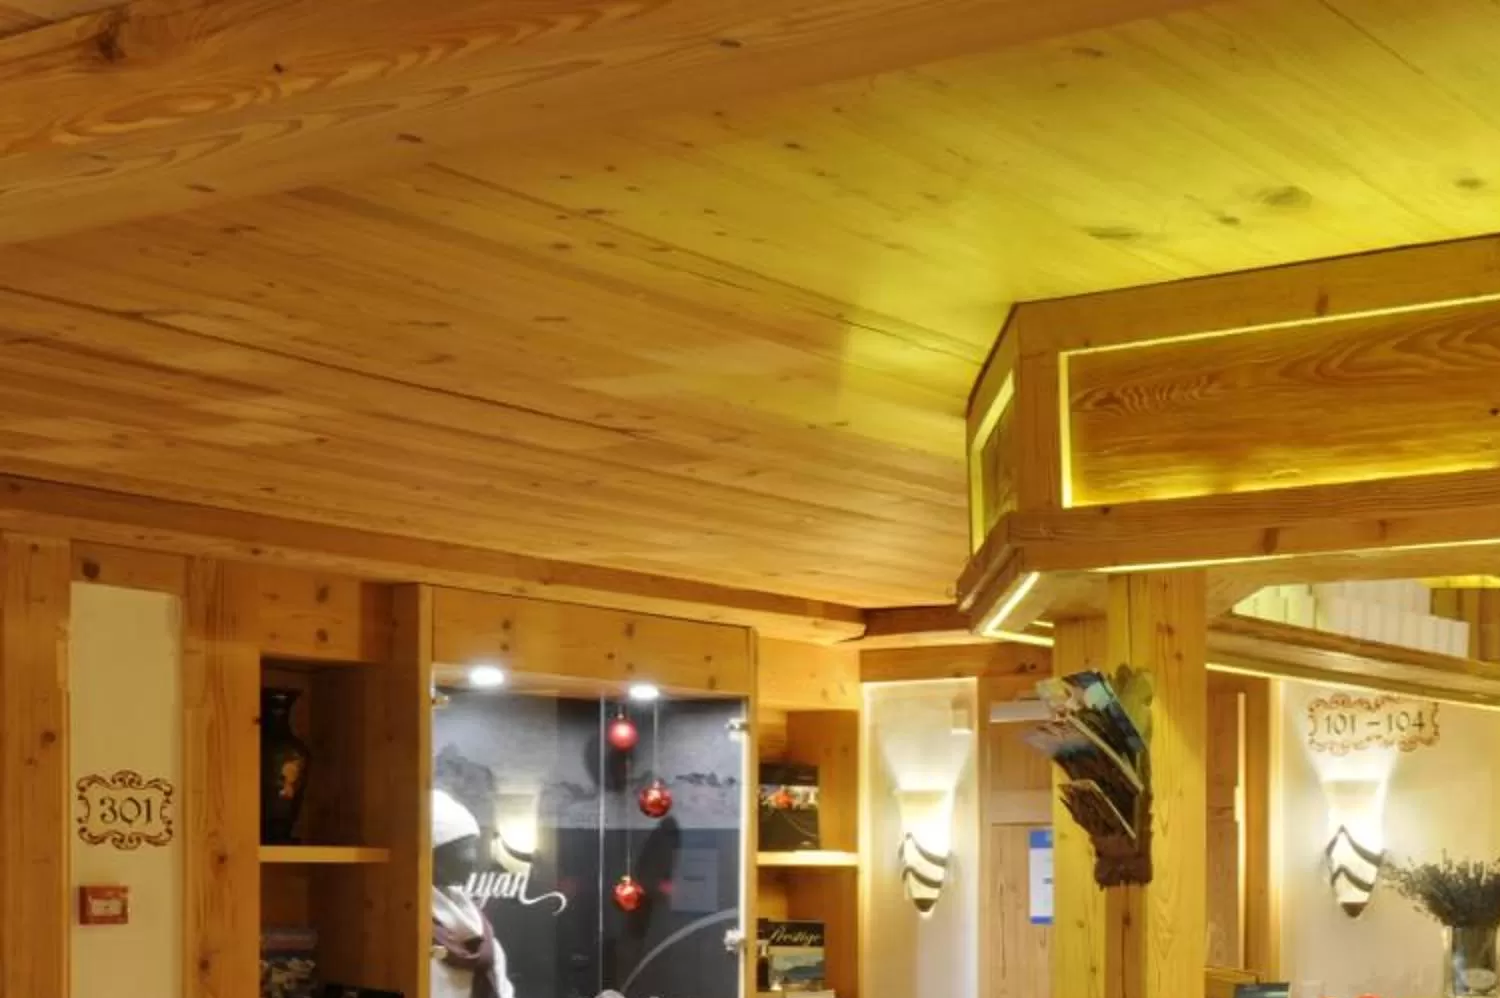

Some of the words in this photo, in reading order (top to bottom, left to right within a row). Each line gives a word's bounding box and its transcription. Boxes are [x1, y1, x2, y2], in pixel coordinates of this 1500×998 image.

[1325, 713, 1356, 736] 101
[1386, 710, 1425, 733] 104
[100, 796, 151, 826] 301
